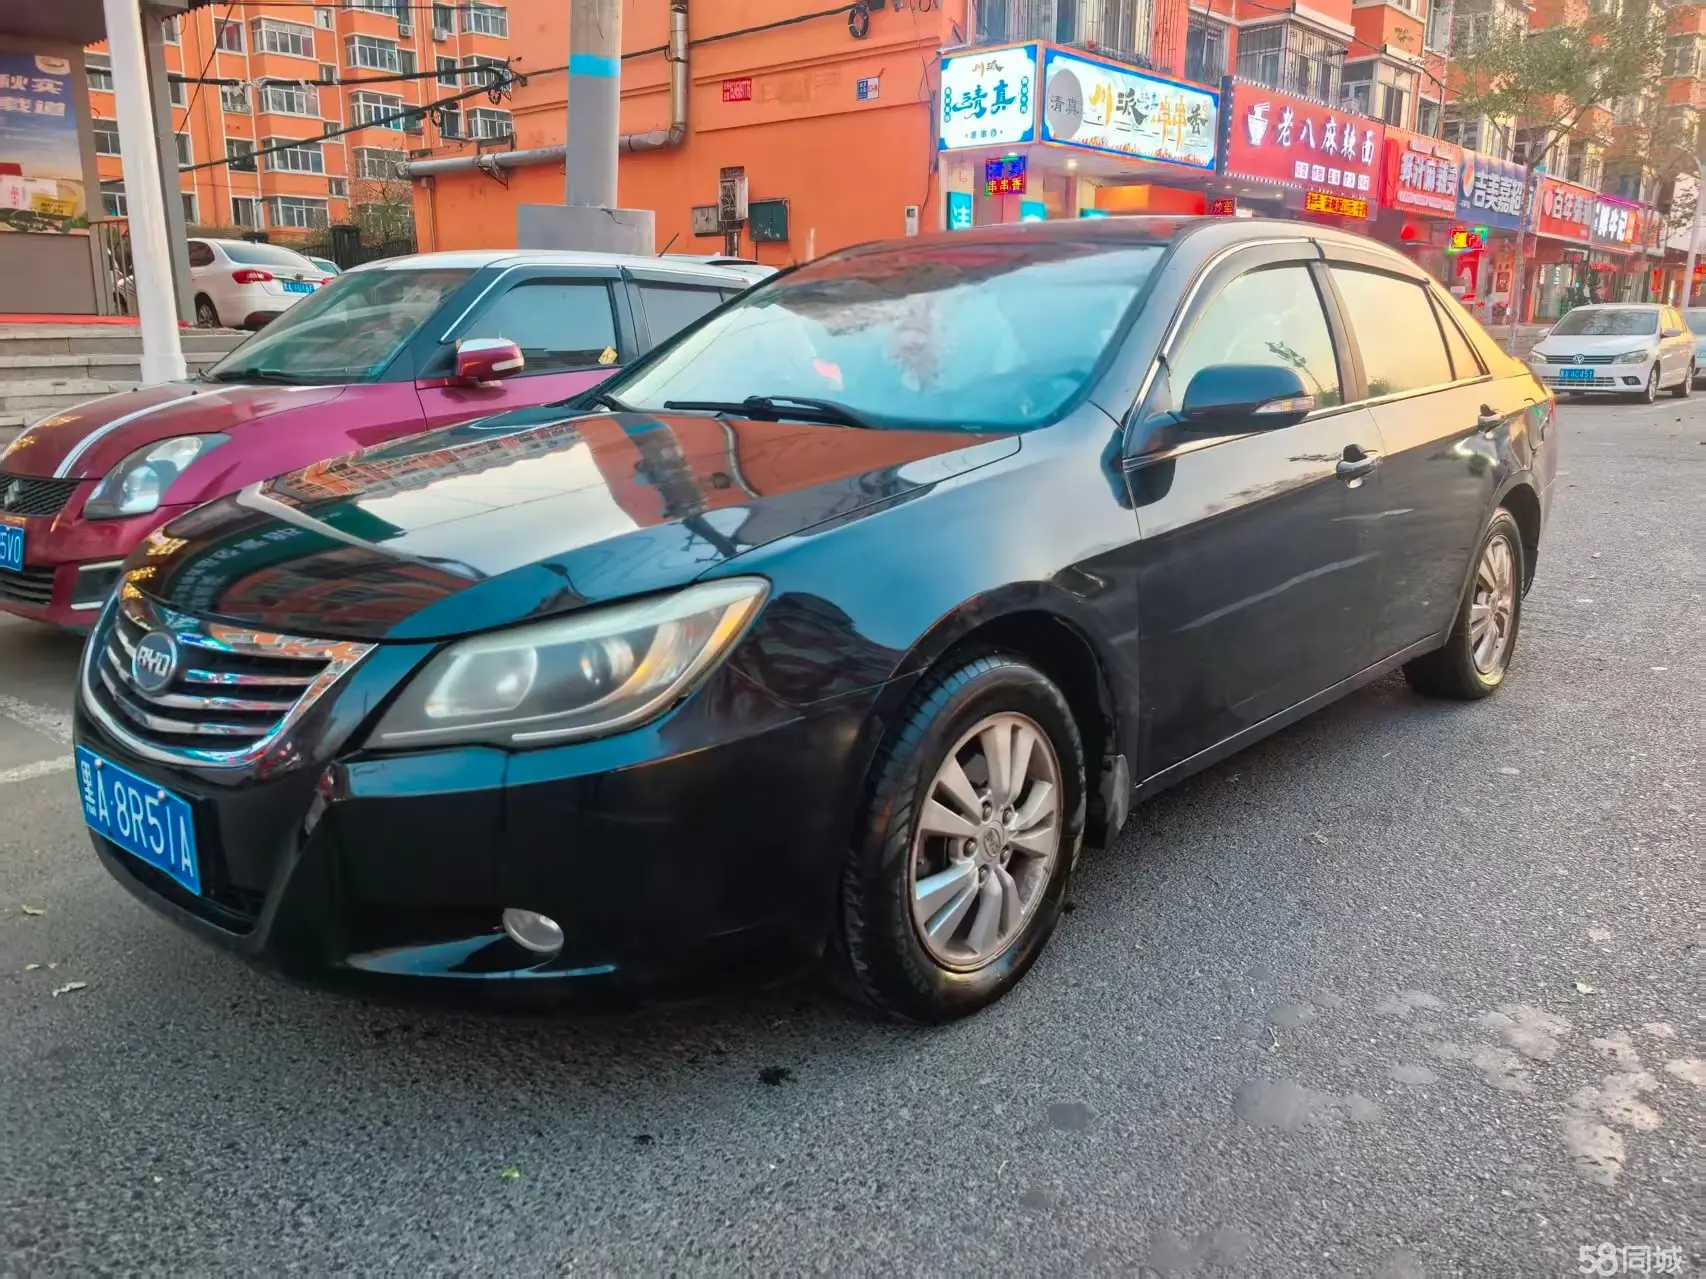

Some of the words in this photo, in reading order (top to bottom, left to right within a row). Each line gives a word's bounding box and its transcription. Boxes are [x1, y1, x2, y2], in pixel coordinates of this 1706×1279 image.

[1277, 106, 1375, 166] 老八麻辣面
[987, 177, 1022, 193] 串串香
